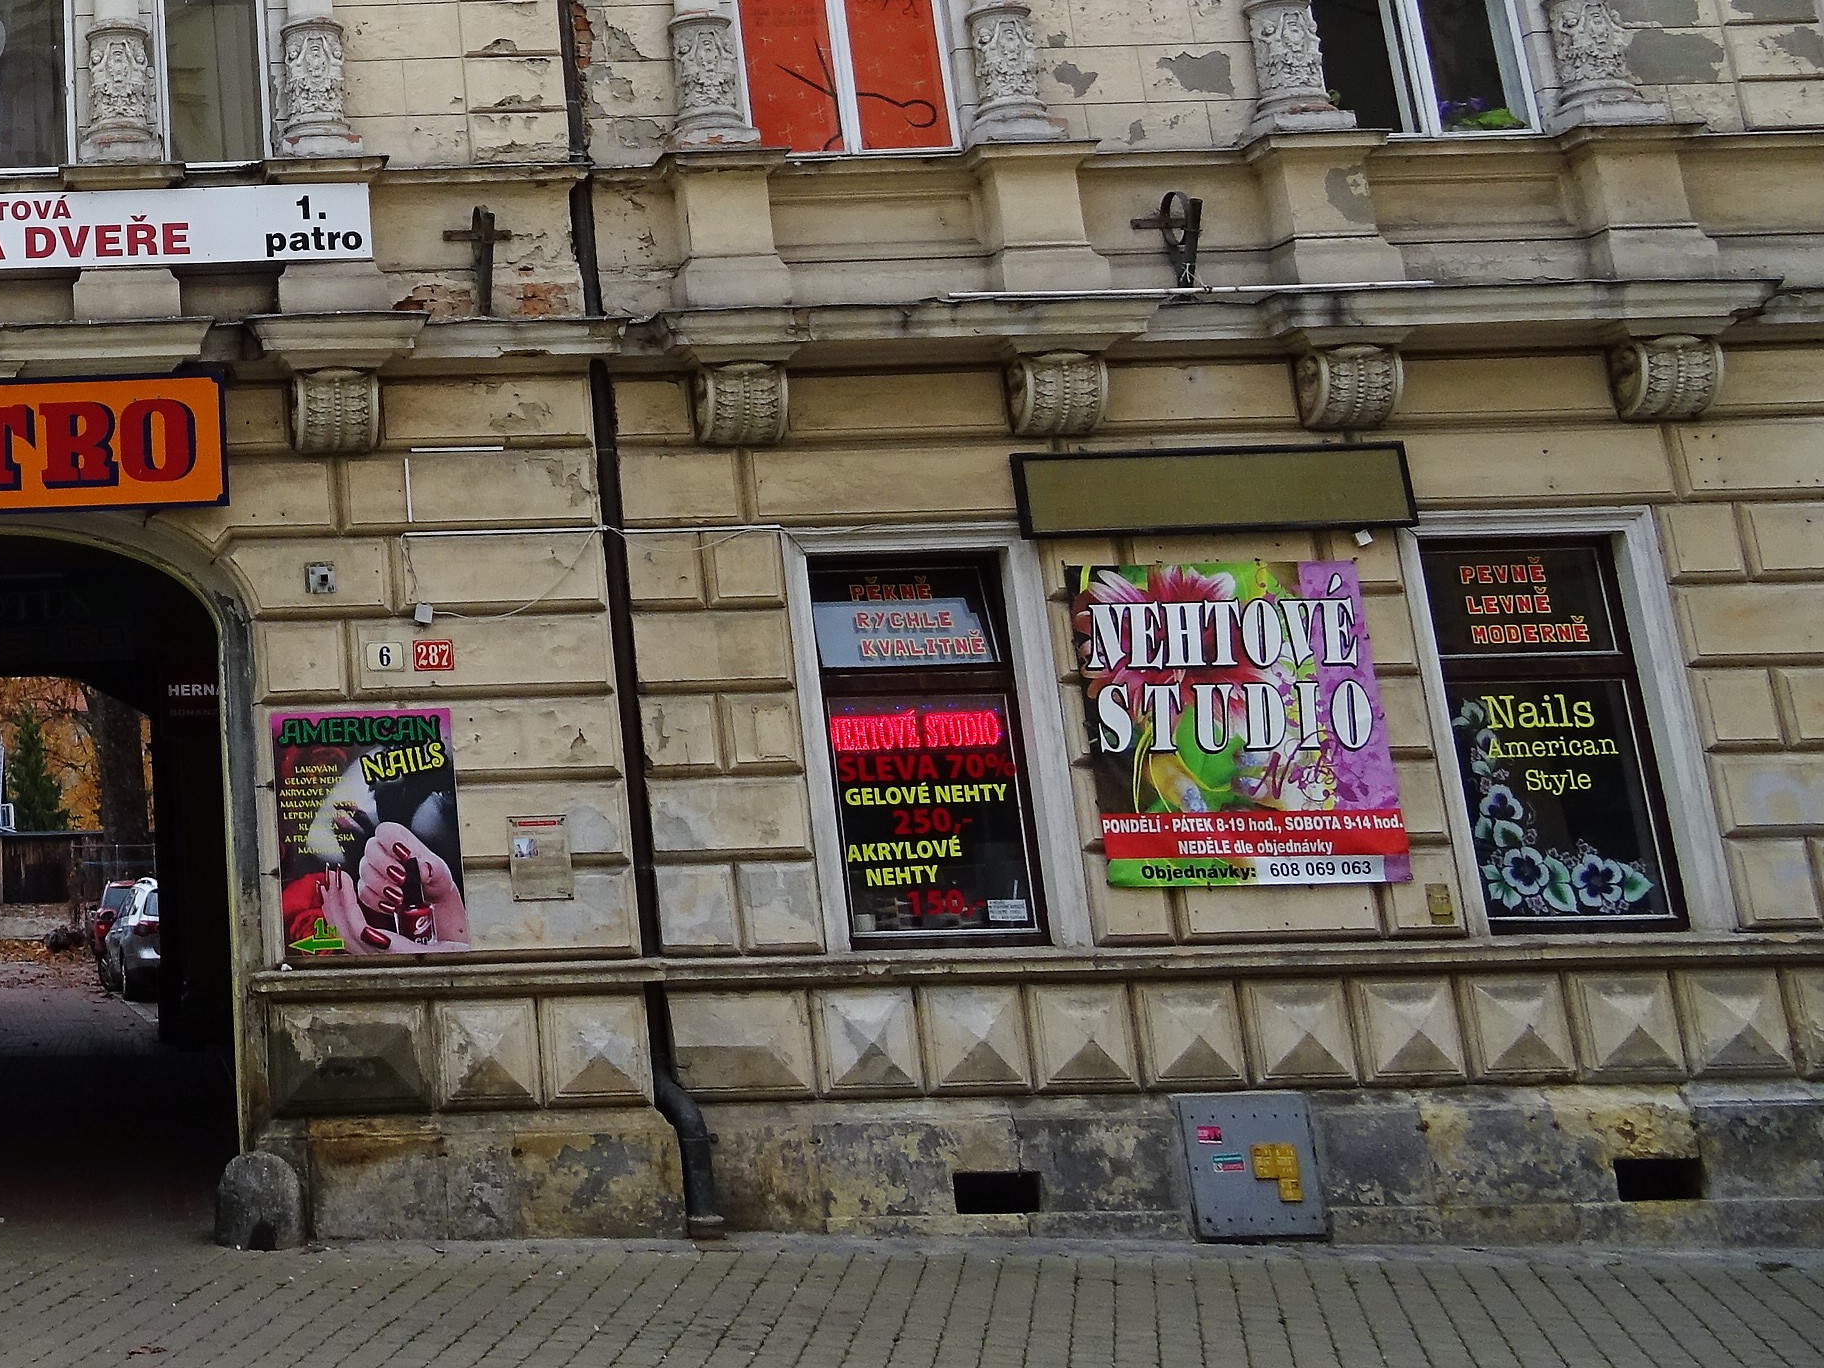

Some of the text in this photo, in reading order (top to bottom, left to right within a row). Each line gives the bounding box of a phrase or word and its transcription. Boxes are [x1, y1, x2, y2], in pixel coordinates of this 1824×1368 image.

[296, 195, 326, 220] 1.
[25, 215, 196, 260] DVEŘE
[266, 227, 362, 257] patro
[1459, 556, 1546, 584] PEVNĚ
[849, 576, 932, 602] PĚKNĚ
[1465, 586, 1551, 614] LEVNĚ
[856, 611, 954, 629] RYCHLE
[1087, 572, 1359, 671] NEHTOVÉ
[1470, 615, 1590, 644] MODERNĚ
[379, 645, 391, 667] 6
[417, 644, 449, 667] 287
[860, 629, 986, 657] KVALITNĚ
[1097, 679, 1374, 756] STUDIO
[1480, 694, 1595, 730] Nails
[279, 717, 437, 744] AMERICAN
[830, 708, 999, 751] NEHTOVÉ STUDIO
[1488, 736, 1619, 758] American
[362, 742, 445, 782] NAILS
[837, 752, 1017, 784] SLEVA 70%
[845, 783, 1007, 805] GELOVÉ NEHTY
[1525, 769, 1592, 795] Style
[892, 807, 973, 835] 250,-
[1102, 815, 1161, 834] PONDĚLÍ
[1172, 814, 1214, 833] PÁTEK
[1216, 817, 1245, 832] 8-19
[1249, 817, 1282, 834] hod.,
[1285, 816, 1342, 831] SOBOTA
[1343, 815, 1371, 830] 9-14
[1373, 813, 1404, 829] hod.
[847, 835, 963, 863] AKRYLOVÉ
[1178, 836, 1334, 856] NEDĚLE dle objednávky
[865, 864, 938, 887] NEHTY
[1141, 860, 1371, 882] Objednávky: 608 069 063
[907, 890, 987, 918] 150,-
